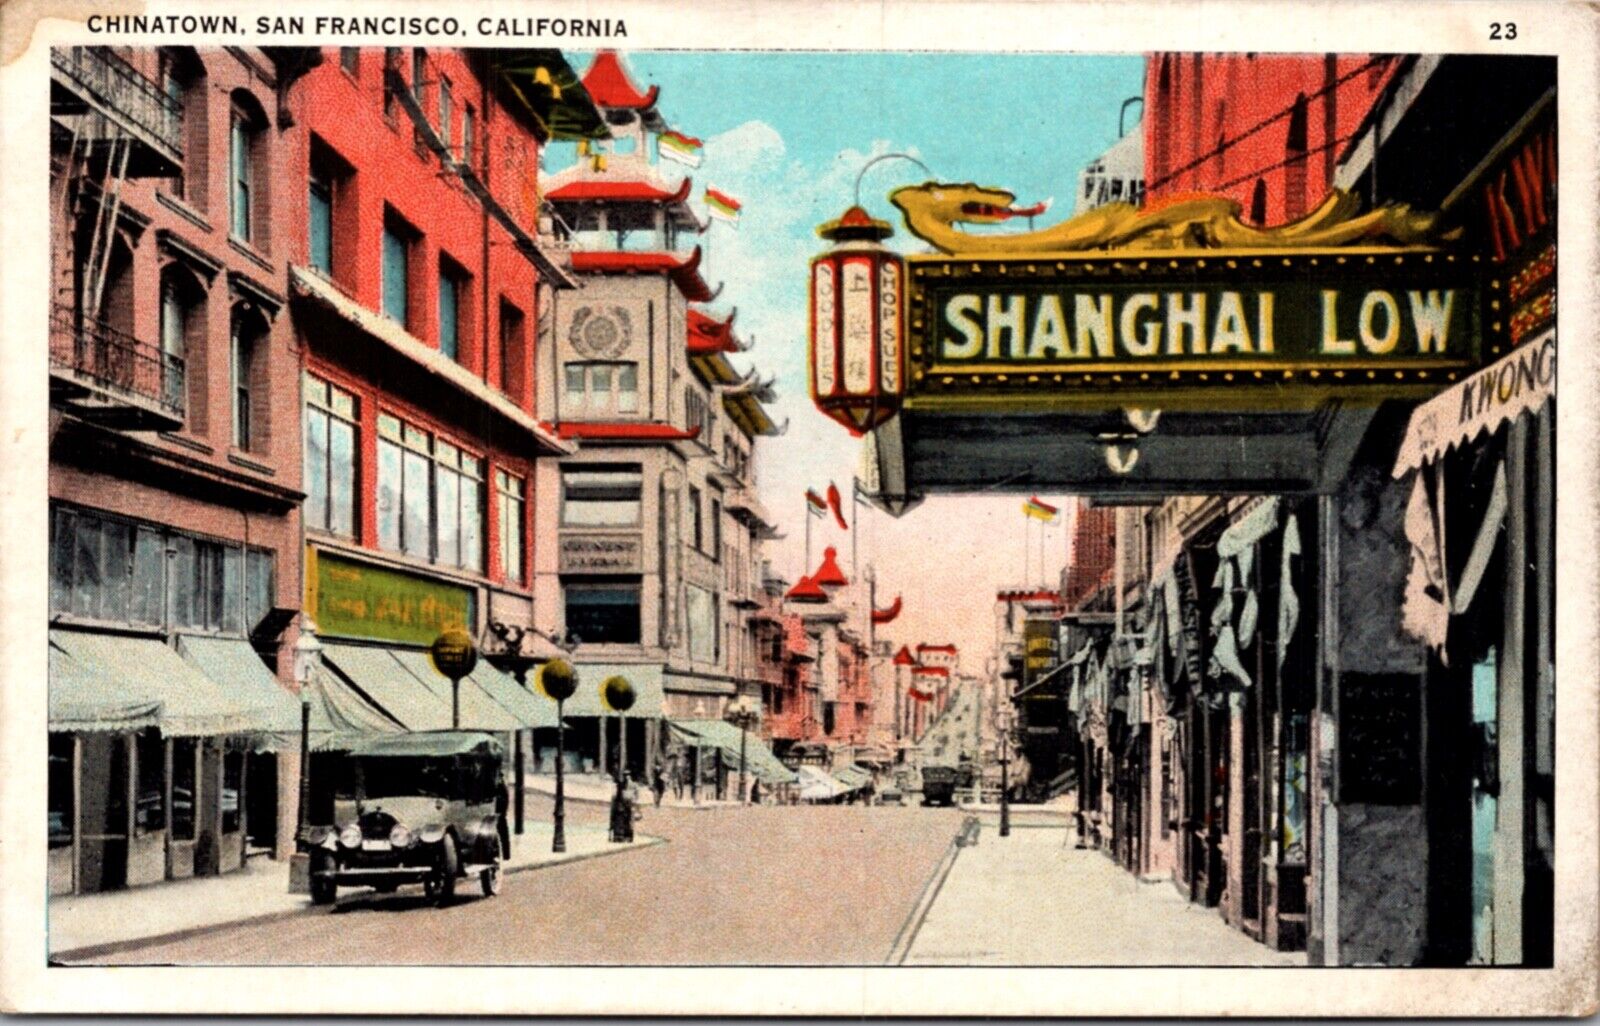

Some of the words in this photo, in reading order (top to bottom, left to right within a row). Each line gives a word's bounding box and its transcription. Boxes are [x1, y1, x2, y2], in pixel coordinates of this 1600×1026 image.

[881, 262, 897, 320] CHOP
[943, 292, 1275, 358] SHANGHAI
[1321, 290, 1454, 354] LOW
[882, 327, 897, 389] SUEY
[1459, 337, 1556, 425] KWONG
